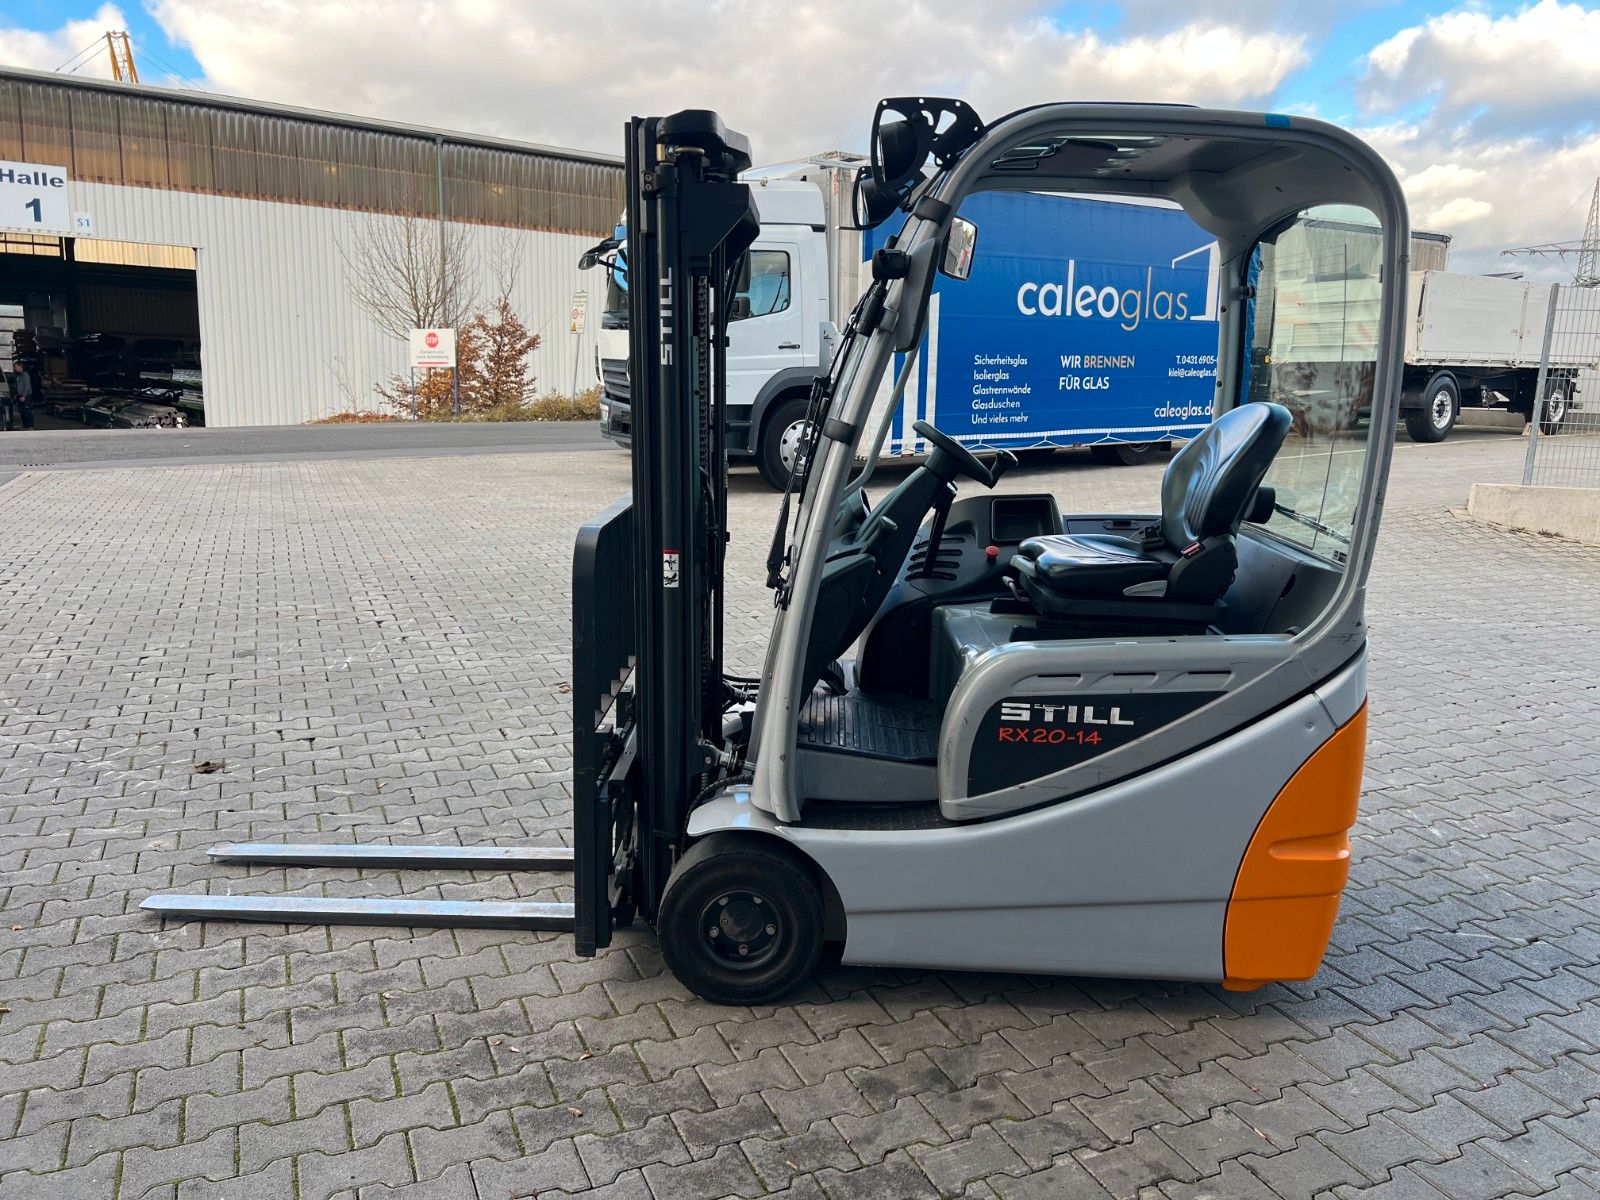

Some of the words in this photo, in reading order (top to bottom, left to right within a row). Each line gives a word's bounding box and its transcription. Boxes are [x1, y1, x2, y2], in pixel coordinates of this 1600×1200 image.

[0, 168, 65, 188] Halle
[25, 197, 42, 223] 1
[1017, 259, 1188, 331] caleoglas
[660, 266, 673, 366] STILL
[974, 354, 1028, 367] Sicherheitsglas
[1060, 355, 1081, 369] WIR
[1083, 355, 1136, 369] BRENNEN
[1198, 355, 1218, 365] 6905-
[973, 368, 1010, 382] Isolierglas
[1168, 367, 1218, 379] kiel@caleoglas.d
[972, 382, 1032, 395] Glastrennwände
[1059, 374, 1080, 390] FÜR
[1082, 376, 1110, 390] GLAS
[971, 397, 1021, 410] Glasduschen
[971, 412, 988, 425] Und
[988, 412, 1008, 423] vieles
[1009, 411, 1029, 423] mehr
[1000, 702, 1135, 726] STILL
